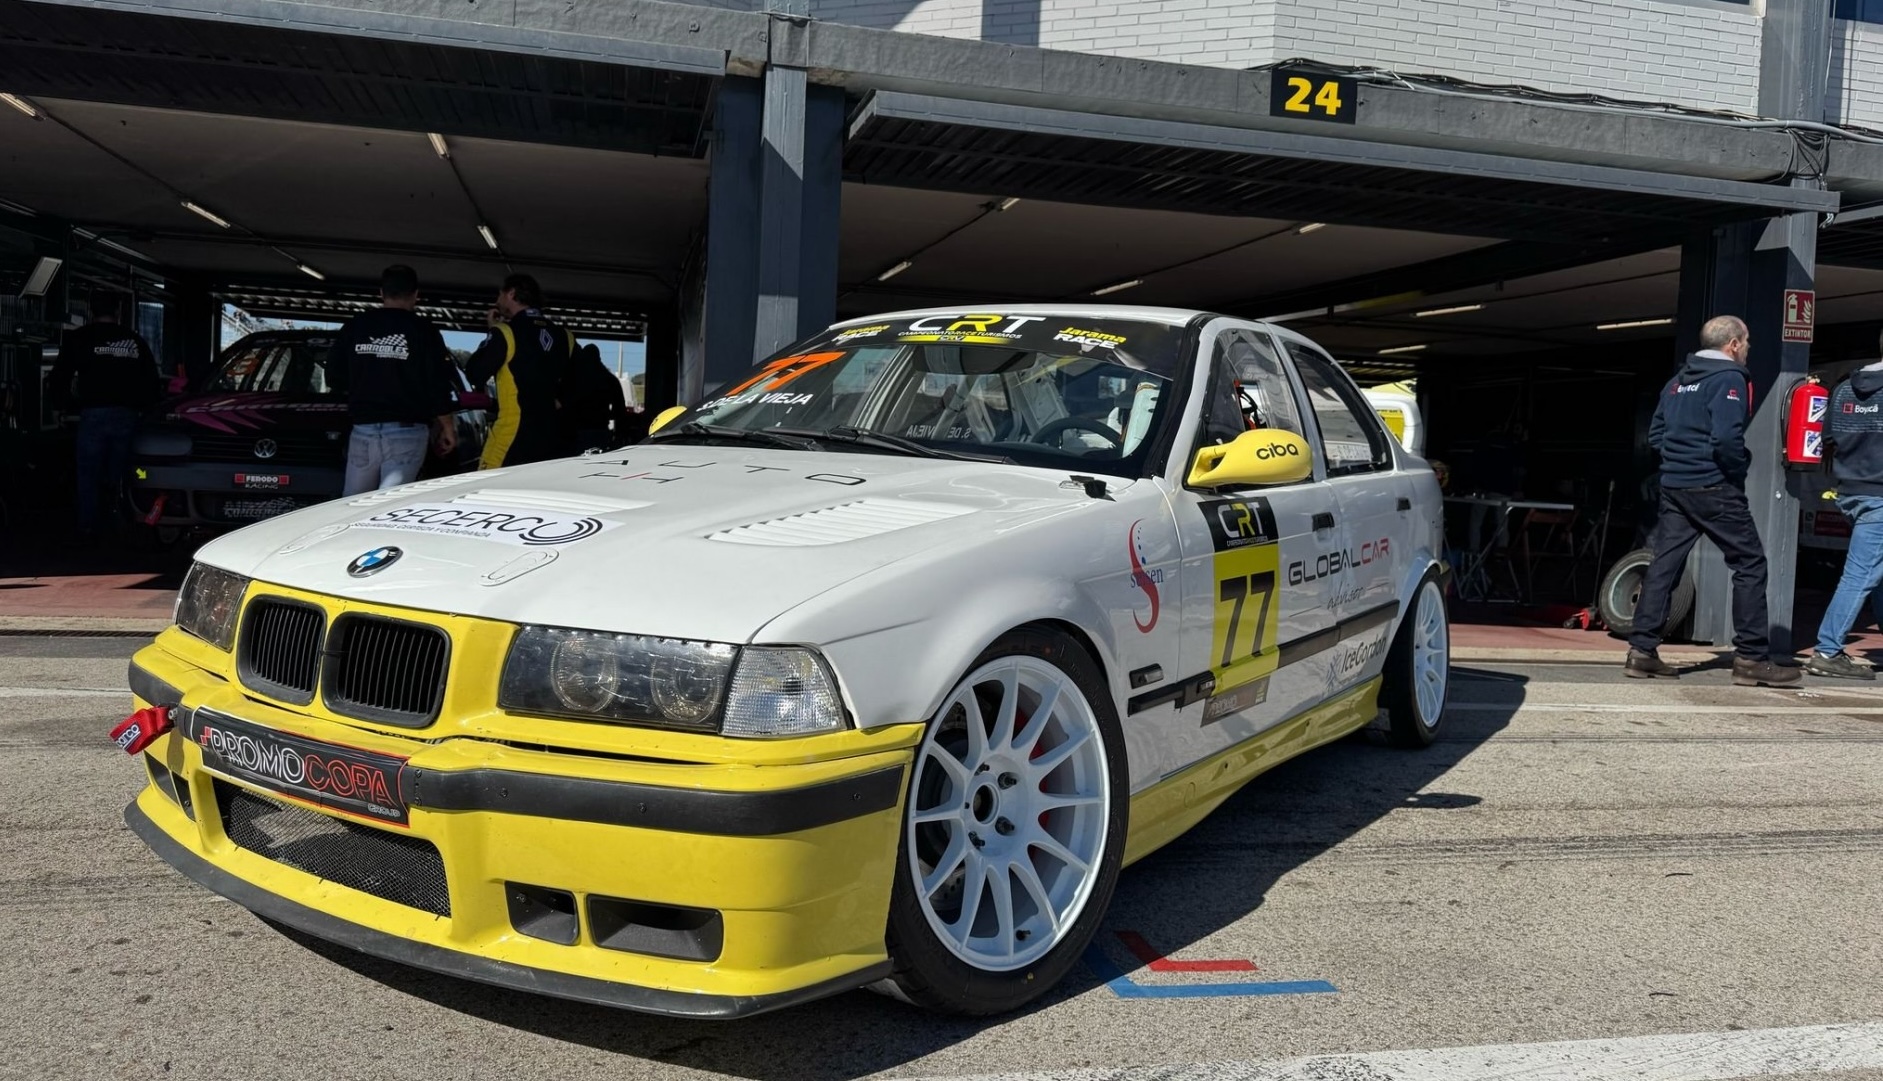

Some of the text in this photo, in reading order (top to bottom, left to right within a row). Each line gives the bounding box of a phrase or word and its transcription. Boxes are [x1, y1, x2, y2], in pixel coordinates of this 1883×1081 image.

[1285, 77, 1342, 115] 24
[908, 314, 1047, 334] CRT
[1784, 328, 1811, 338] EXTINTOR
[1053, 333, 1119, 349] RACE
[1059, 326, 1127, 344] Jarama
[725, 351, 847, 397] 77
[732, 393, 759, 405] LA
[759, 393, 814, 405] VIEJA
[1256, 442, 1299, 461] ciba
[246, 475, 279, 483] FERODO
[1217, 502, 1263, 538] CRT
[1288, 537, 1390, 587] GLOBALCAR
[1220, 570, 1275, 668] 77
[1340, 633, 1387, 675] IceGordon
[210, 727, 398, 808] PROMOCOPA
[367, 803, 401, 818] GROUP
